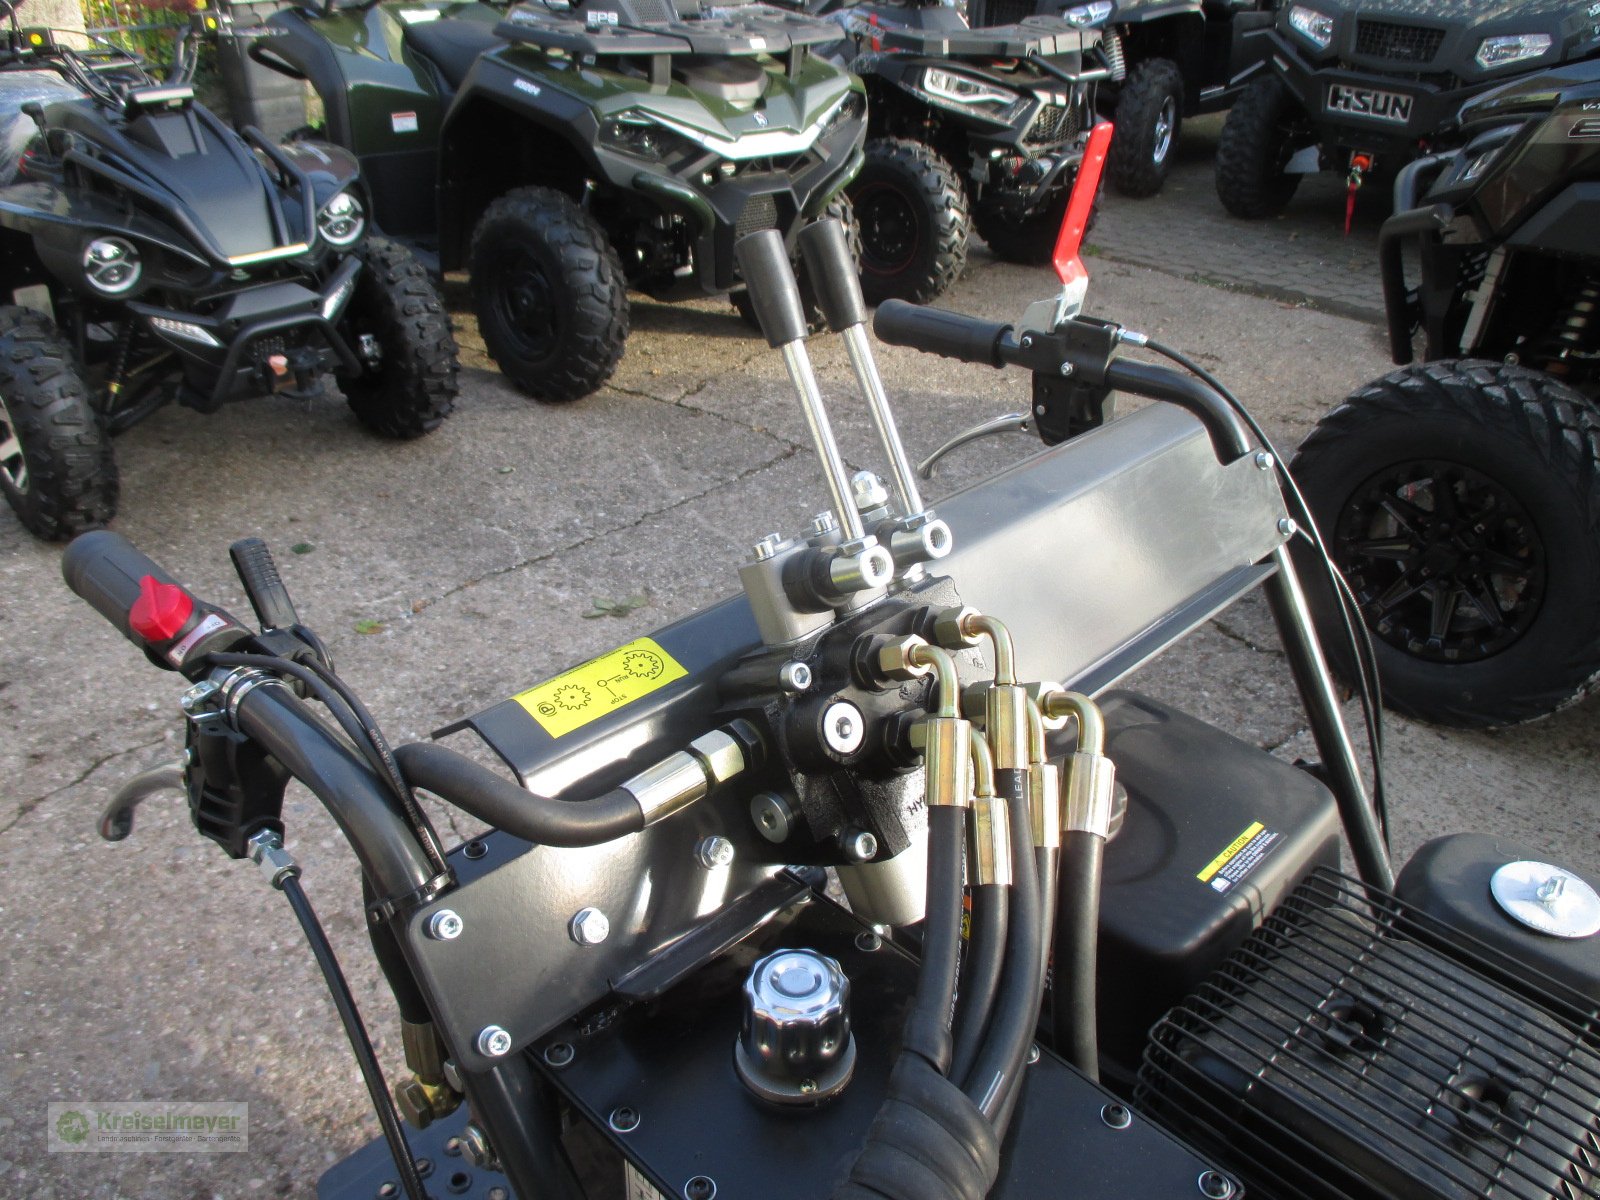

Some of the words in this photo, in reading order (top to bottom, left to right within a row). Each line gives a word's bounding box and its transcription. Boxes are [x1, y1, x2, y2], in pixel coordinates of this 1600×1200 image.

[587, 11, 618, 26] EPS
[615, 674, 629, 684] RUN
[610, 693, 627, 704] STOP
[1223, 835, 1249, 858] CAUTION
